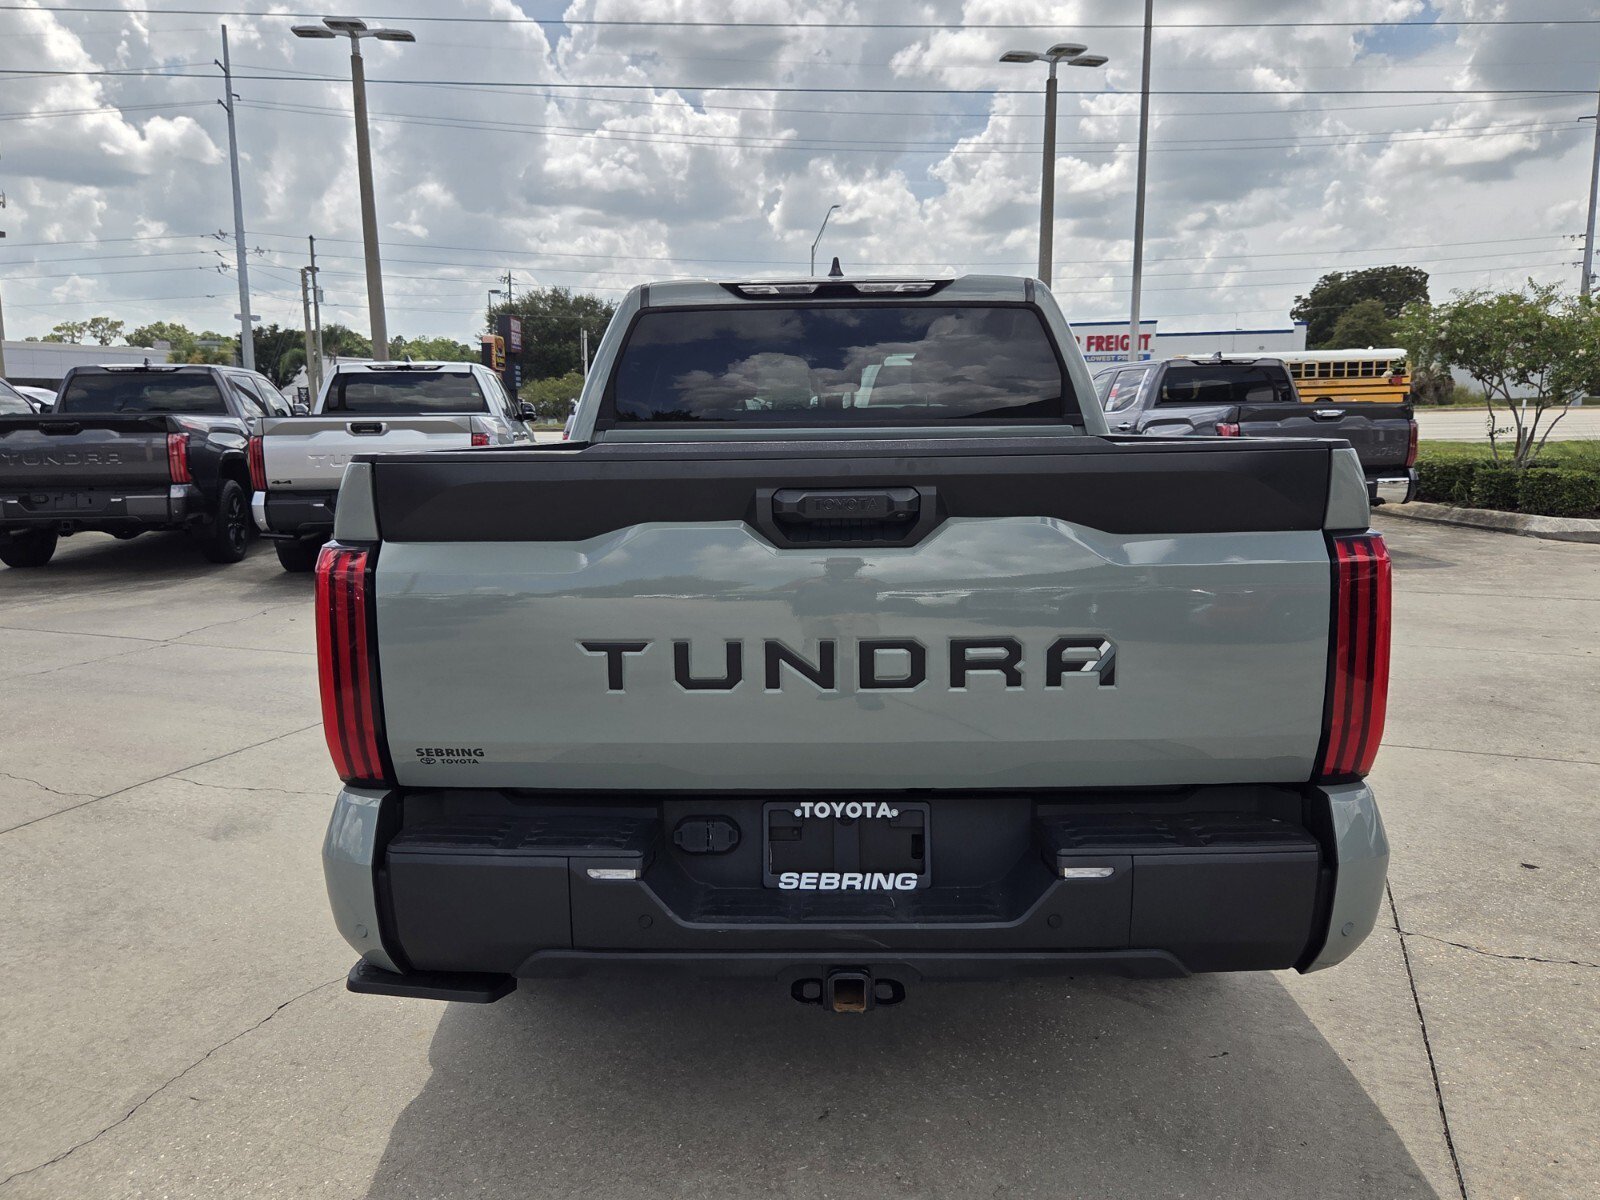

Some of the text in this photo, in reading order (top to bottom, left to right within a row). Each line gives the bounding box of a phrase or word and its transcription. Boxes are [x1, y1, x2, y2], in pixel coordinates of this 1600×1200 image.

[1087, 334, 1151, 351] FREIGT
[1, 451, 123, 466] TUNDRA
[815, 497, 880, 512] TOYOTA
[575, 636, 1120, 696] TUNDRA
[415, 747, 485, 757] SEBRING
[800, 802, 893, 819] TOYOTA
[778, 872, 918, 890] SEBRING
